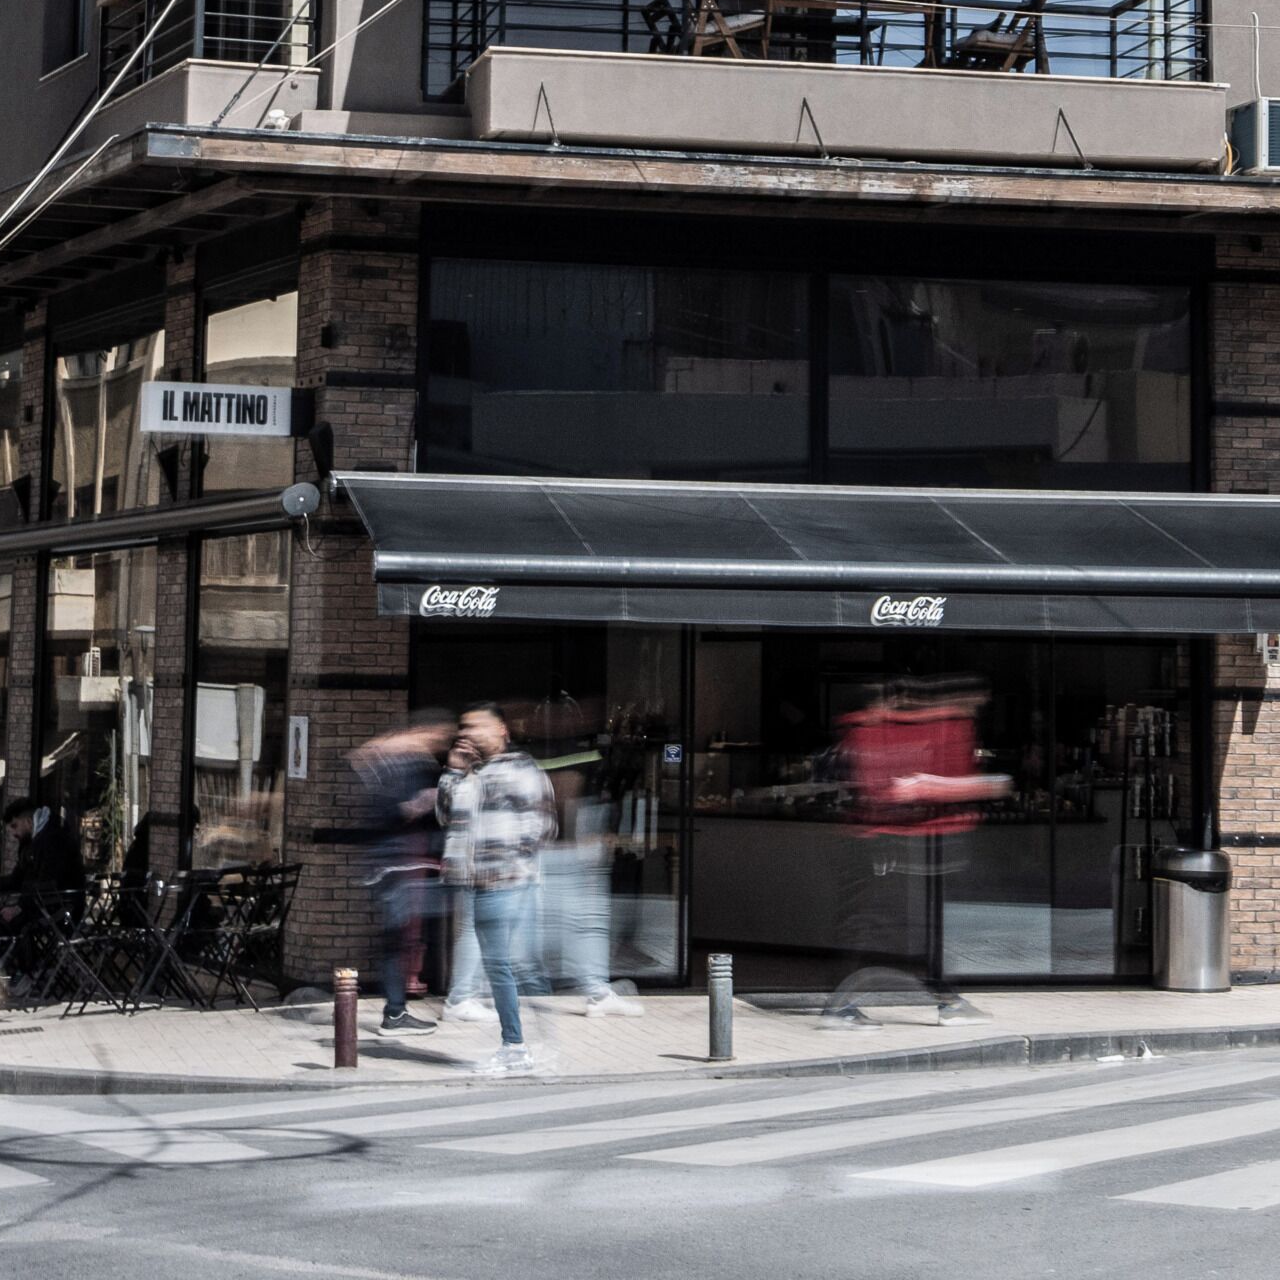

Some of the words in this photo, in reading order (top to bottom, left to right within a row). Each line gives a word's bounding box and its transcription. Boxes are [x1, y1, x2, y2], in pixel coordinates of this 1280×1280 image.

[162, 390, 178, 421] IL
[182, 391, 268, 425] MATTINO
[420, 585, 500, 617] Coca-Cola
[871, 595, 947, 626] Coca-Cola
